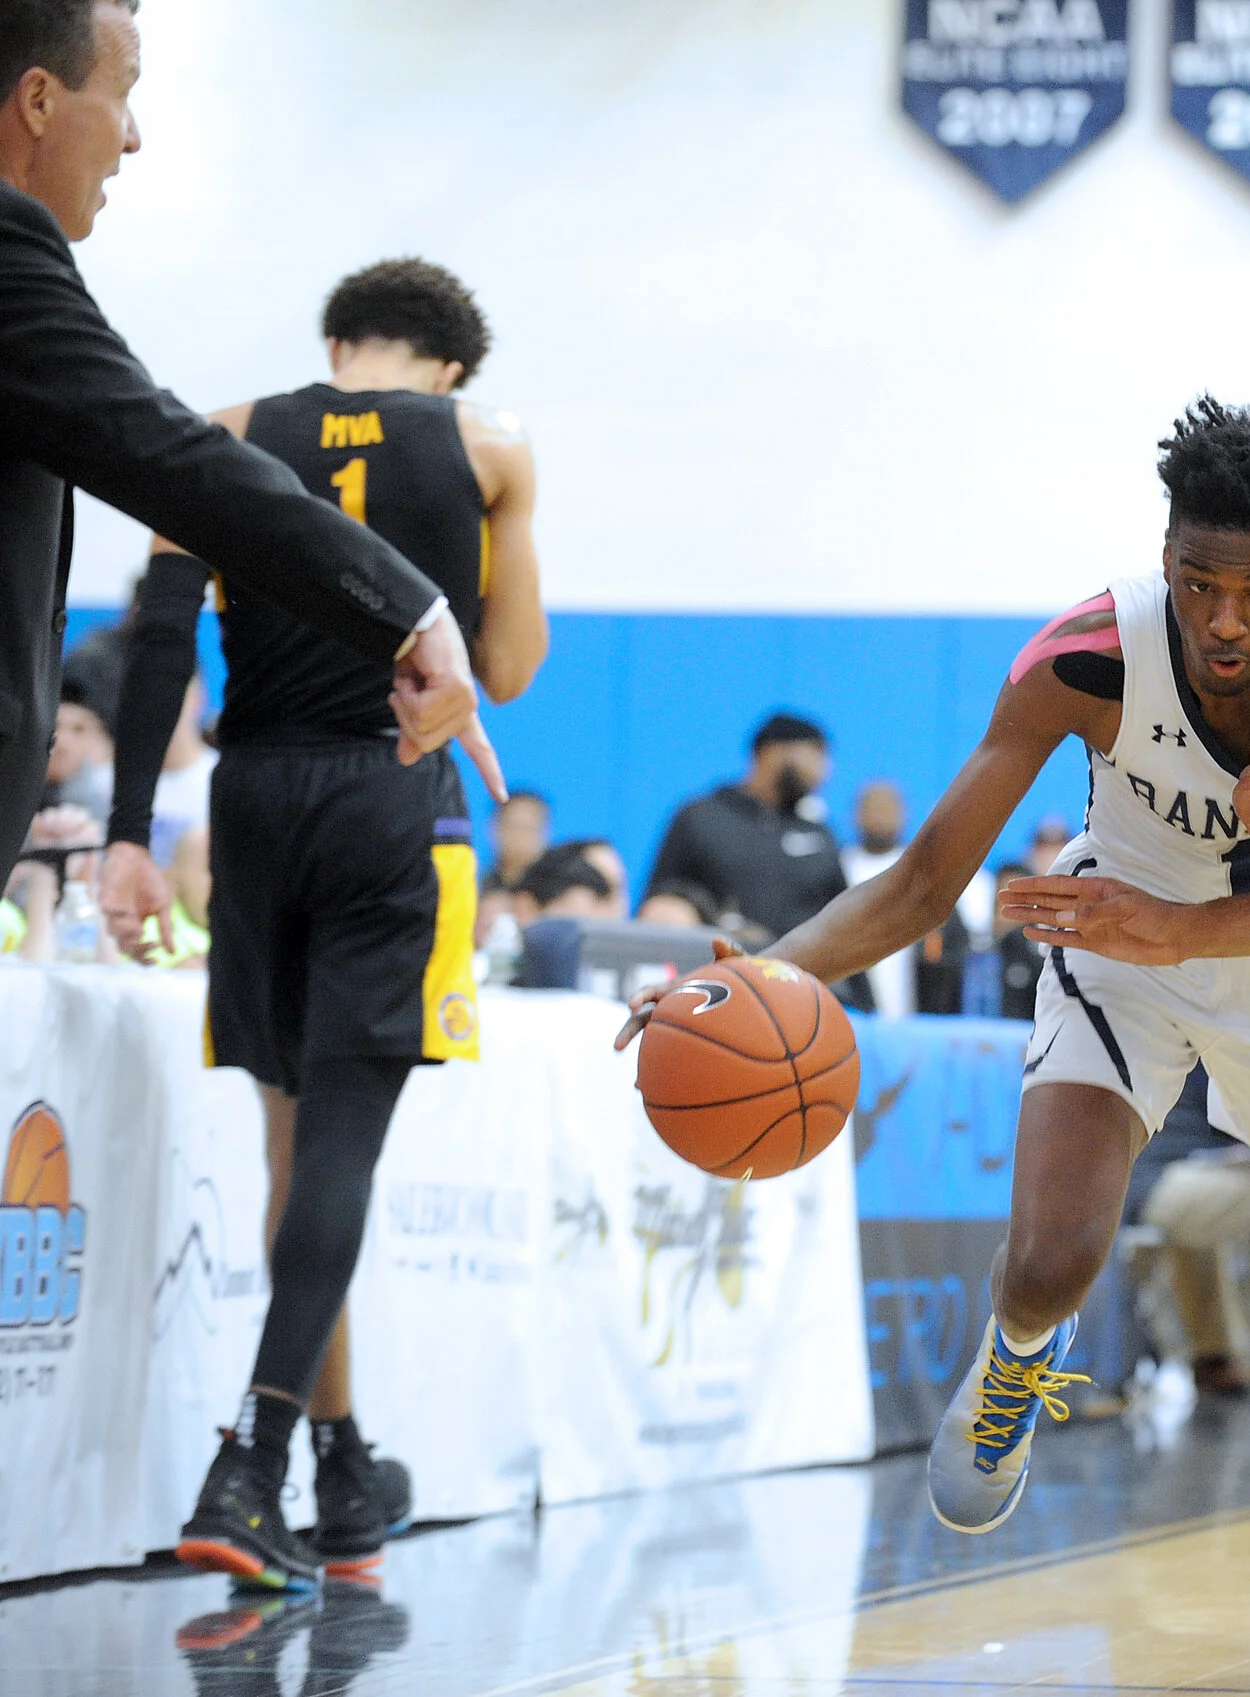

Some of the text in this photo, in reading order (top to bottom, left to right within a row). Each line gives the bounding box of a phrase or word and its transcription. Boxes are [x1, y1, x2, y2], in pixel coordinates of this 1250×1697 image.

[928, 0, 1104, 42] NCAA
[938, 86, 1092, 147] 2007
[320, 411, 384, 448] MVA
[331, 458, 367, 525] 1
[1127, 772, 1242, 840] RAN
